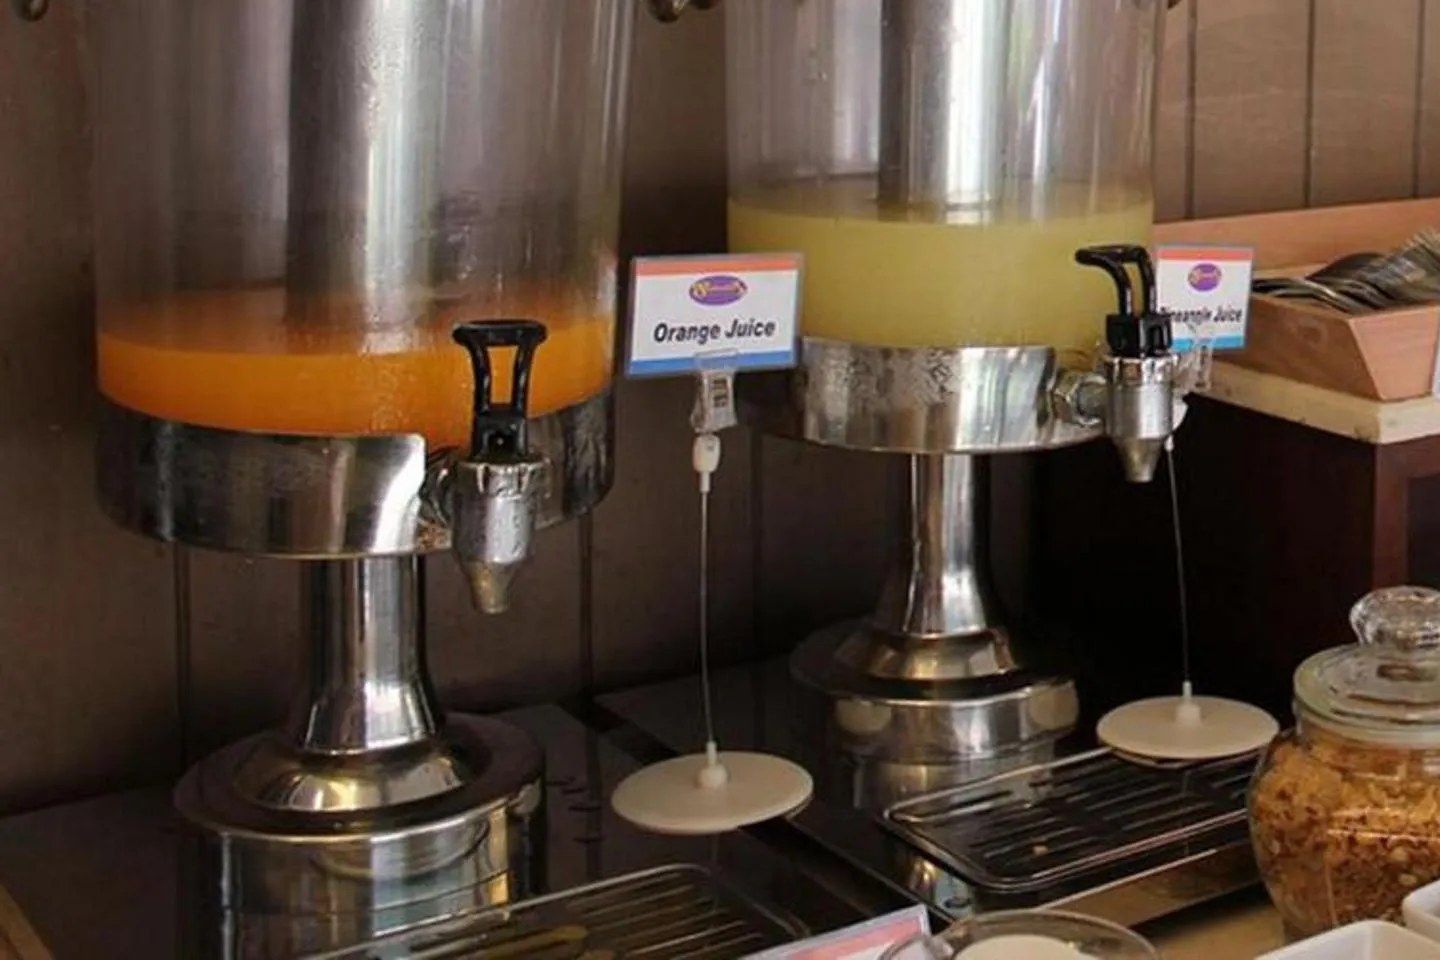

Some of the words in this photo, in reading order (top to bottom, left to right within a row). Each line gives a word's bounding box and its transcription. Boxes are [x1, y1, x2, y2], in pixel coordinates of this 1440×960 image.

[1159, 306, 1212, 325] neapple
[1213, 305, 1243, 322] Juice
[654, 322, 721, 345] Orange
[725, 318, 776, 338] Juice
